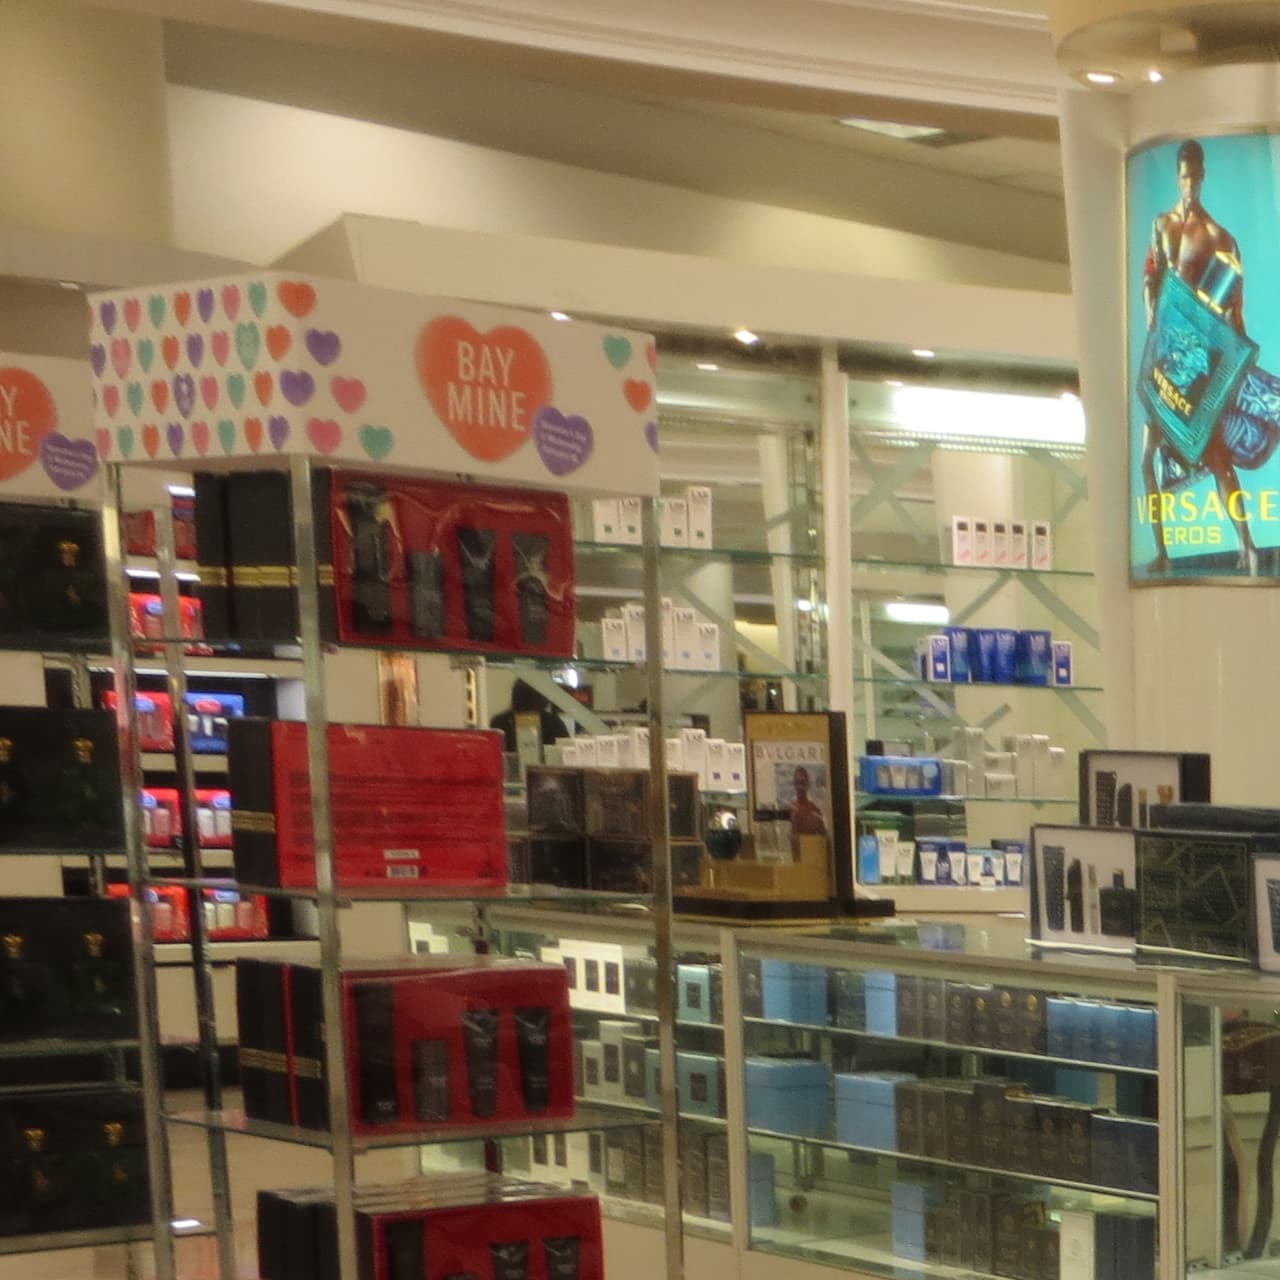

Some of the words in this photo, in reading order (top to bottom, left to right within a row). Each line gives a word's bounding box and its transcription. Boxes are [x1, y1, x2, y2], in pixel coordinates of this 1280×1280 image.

[458, 340, 514, 387] BAY
[447, 381, 525, 432] MINE
[1152, 367, 1192, 417] VERSACE
[1137, 490, 1280, 525] VERSACE
[1162, 525, 1222, 545] EROS
[756, 747, 825, 761] BVLGARI
